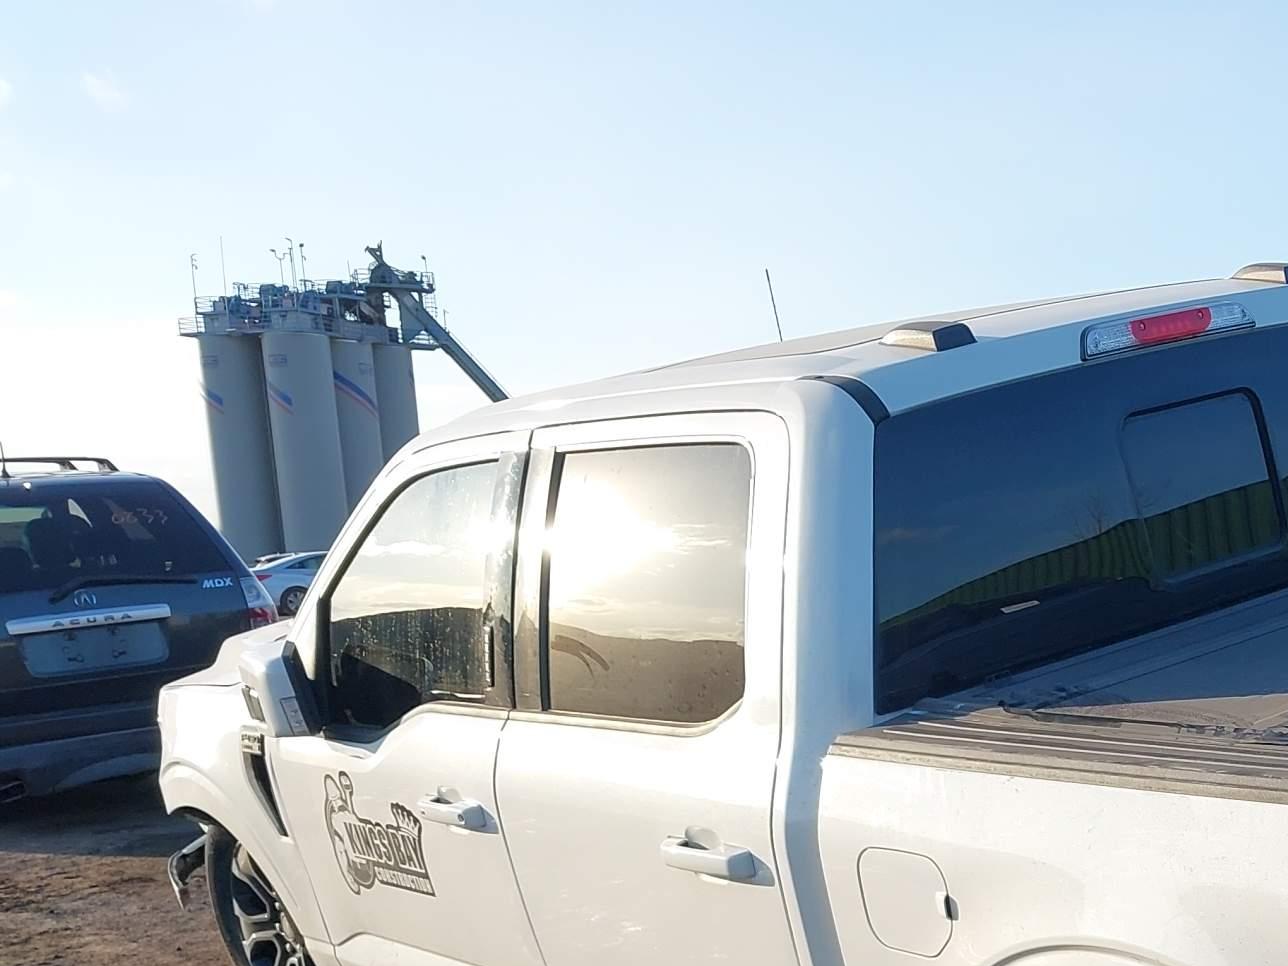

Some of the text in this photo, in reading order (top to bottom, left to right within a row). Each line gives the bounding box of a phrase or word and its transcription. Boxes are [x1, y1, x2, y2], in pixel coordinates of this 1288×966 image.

[202, 577, 233, 589] MDX
[52, 613, 133, 628] ACURA
[344, 821, 427, 872] KINGS BAY
